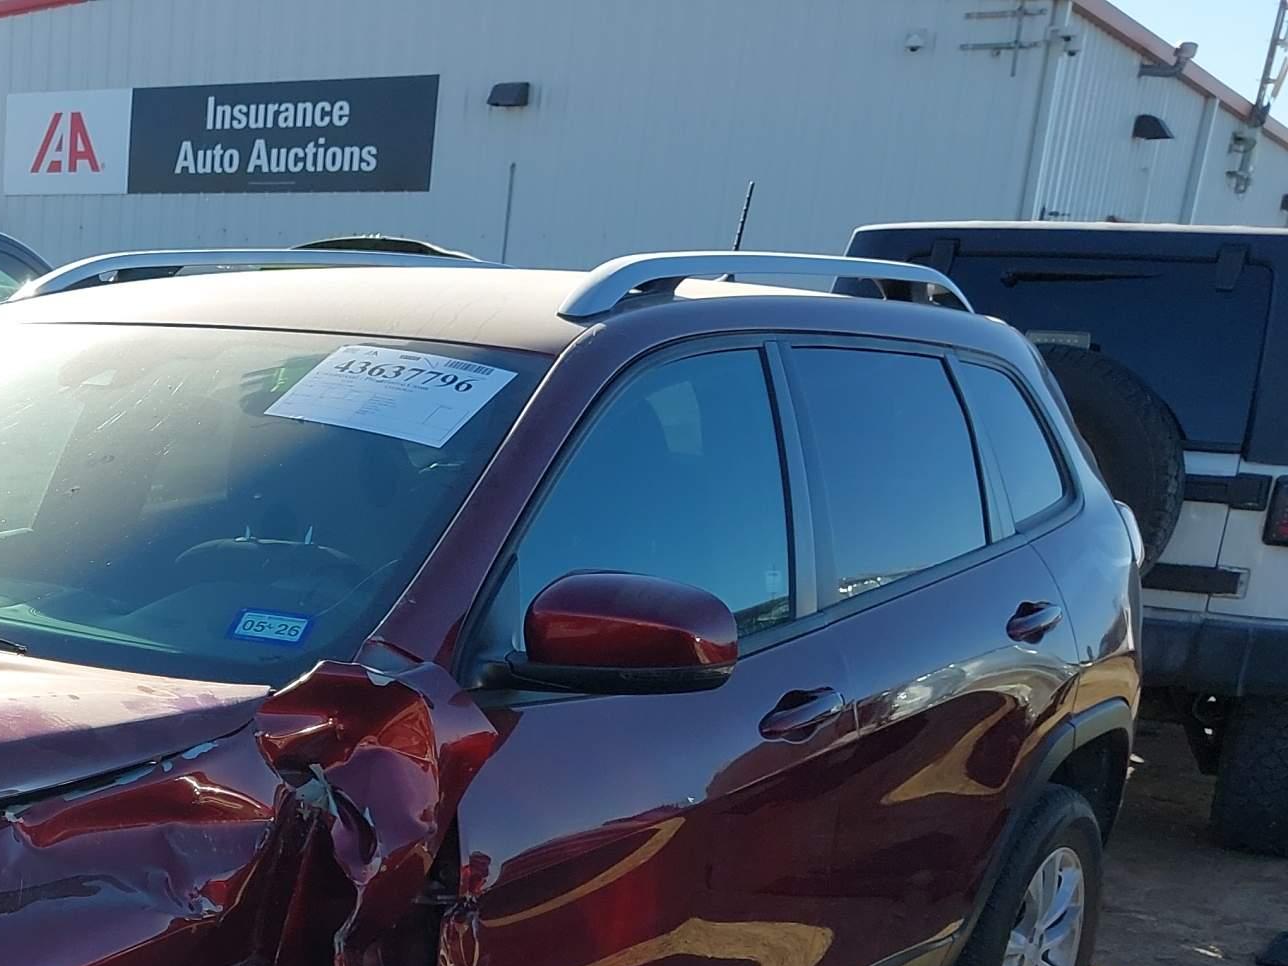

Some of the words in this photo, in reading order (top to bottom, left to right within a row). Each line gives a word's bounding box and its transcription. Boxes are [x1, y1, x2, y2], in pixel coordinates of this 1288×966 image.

[206, 96, 350, 131] Insurance
[174, 140, 240, 175] Auto
[247, 137, 378, 173] Auctions
[334, 359, 476, 394] 43637796
[275, 623, 301, 637] 26
